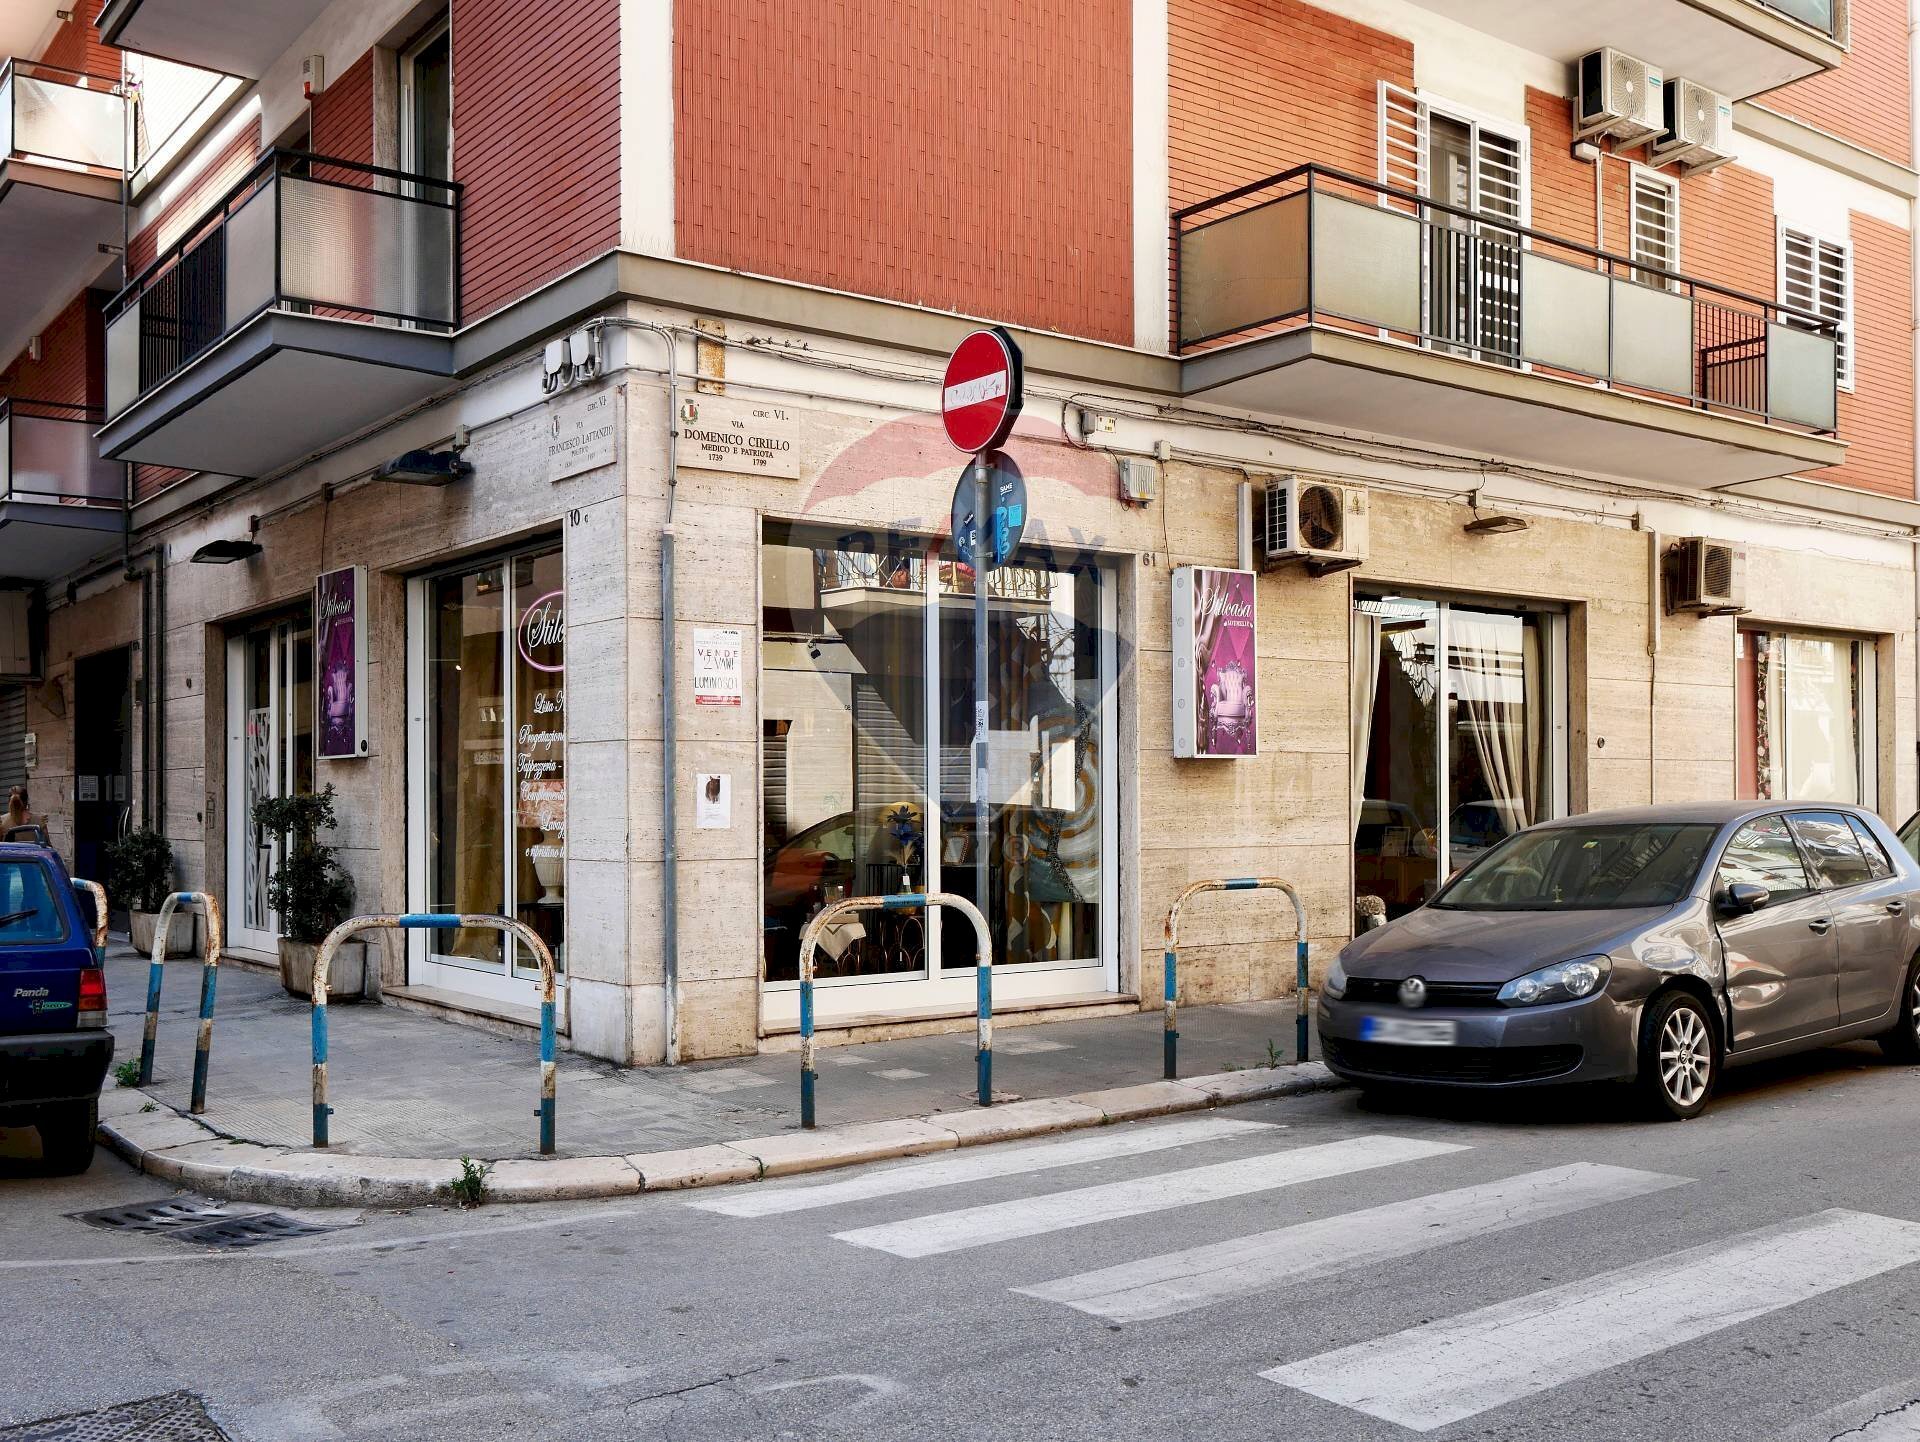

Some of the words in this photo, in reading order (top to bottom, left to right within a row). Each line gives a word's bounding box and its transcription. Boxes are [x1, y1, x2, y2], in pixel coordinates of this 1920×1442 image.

[731, 420, 745, 428] VIA
[548, 436, 580, 457] FRANCESCO
[582, 424, 614, 445] LATTANZIO
[684, 428, 743, 445] DOMENICO
[748, 436, 790, 451] CIRILLO
[701, 443, 730, 453] MEDICO
[741, 447, 774, 458] PATRIOTA
[708, 453, 723, 461] 1739
[753, 458, 767, 467] 1799
[570, 509, 580, 527] 10
[1142, 552, 1156, 567] 61
[697, 648, 739, 658] VENDE
[13, 987, 50, 998] Panda
